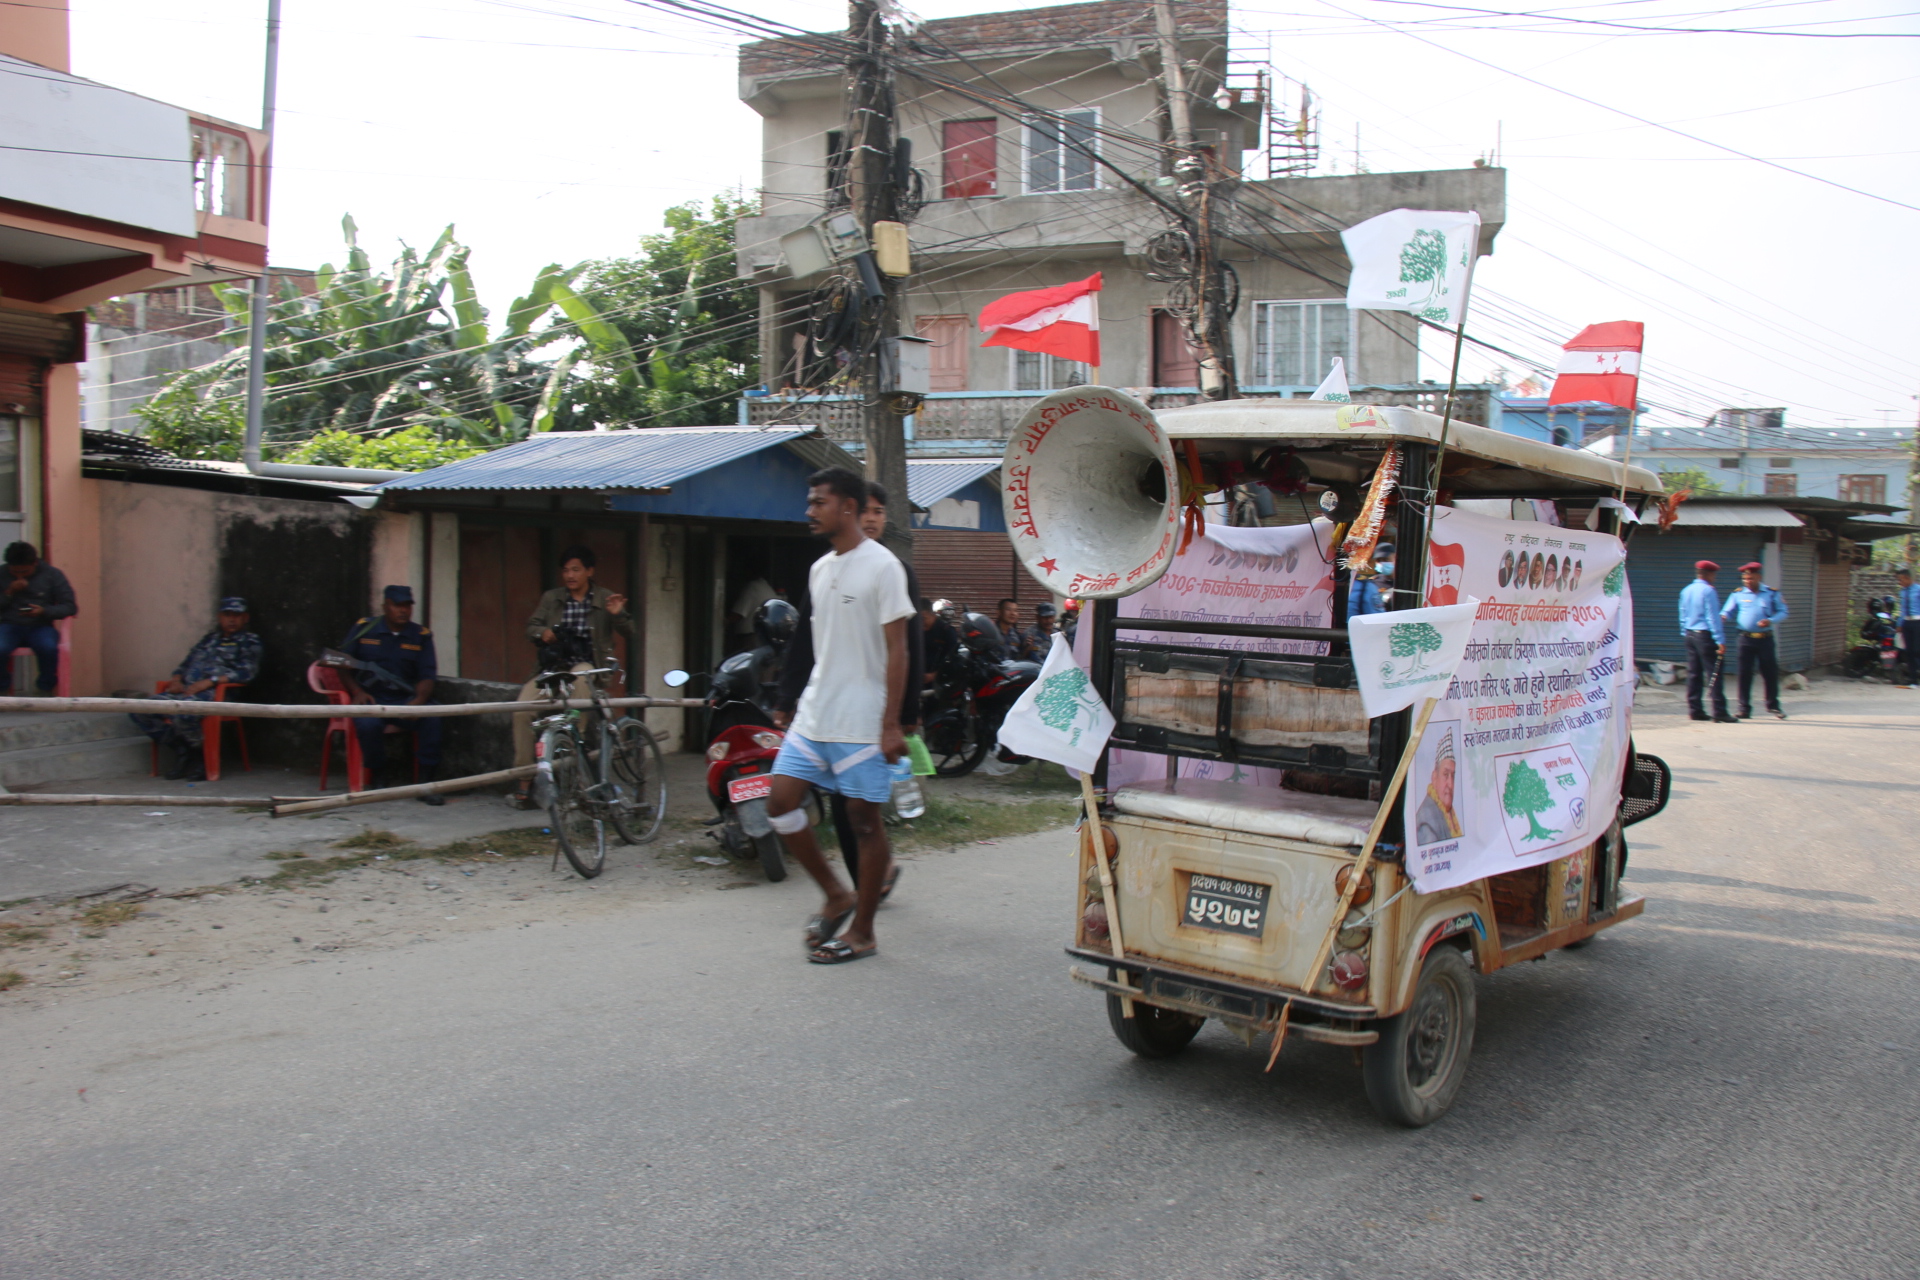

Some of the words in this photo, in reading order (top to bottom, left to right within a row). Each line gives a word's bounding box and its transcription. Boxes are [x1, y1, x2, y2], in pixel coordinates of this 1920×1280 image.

[1005, 465, 1039, 539] उदयपुर
[1538, 637, 1585, 659] नगरपालिका
[1514, 671, 1528, 695] गते
[1531, 670, 1545, 698] हुने
[1526, 699, 1541, 716] छोरा
[1511, 723, 1524, 740] गरी
[1564, 710, 1595, 731] विजयी
[1555, 772, 1577, 791] रुख
[1189, 896, 1260, 930] ५२७९
